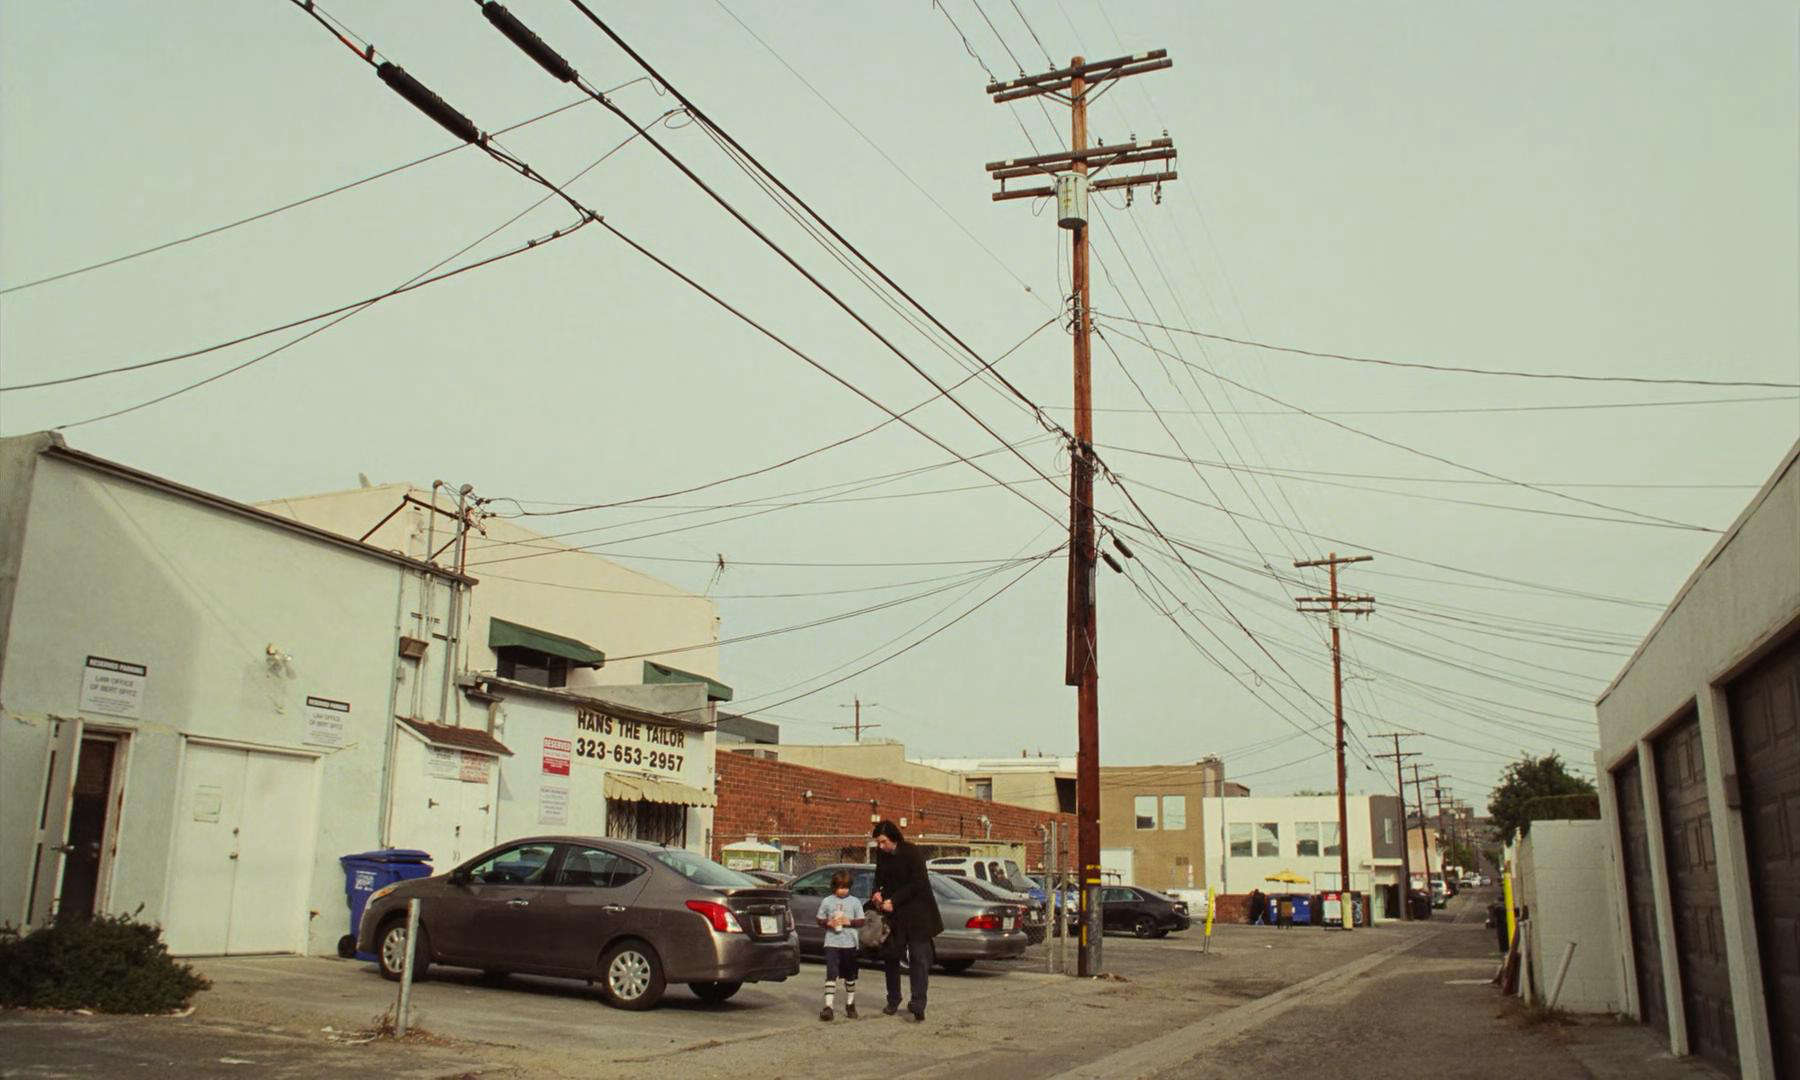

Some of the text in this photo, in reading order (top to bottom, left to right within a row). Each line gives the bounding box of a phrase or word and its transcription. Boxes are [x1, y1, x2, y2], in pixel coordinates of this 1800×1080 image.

[95, 675, 134, 688] LAW OFFICE
[577, 709, 685, 749] HANS THE TAILOR
[576, 737, 684, 772] 323-653-2957
